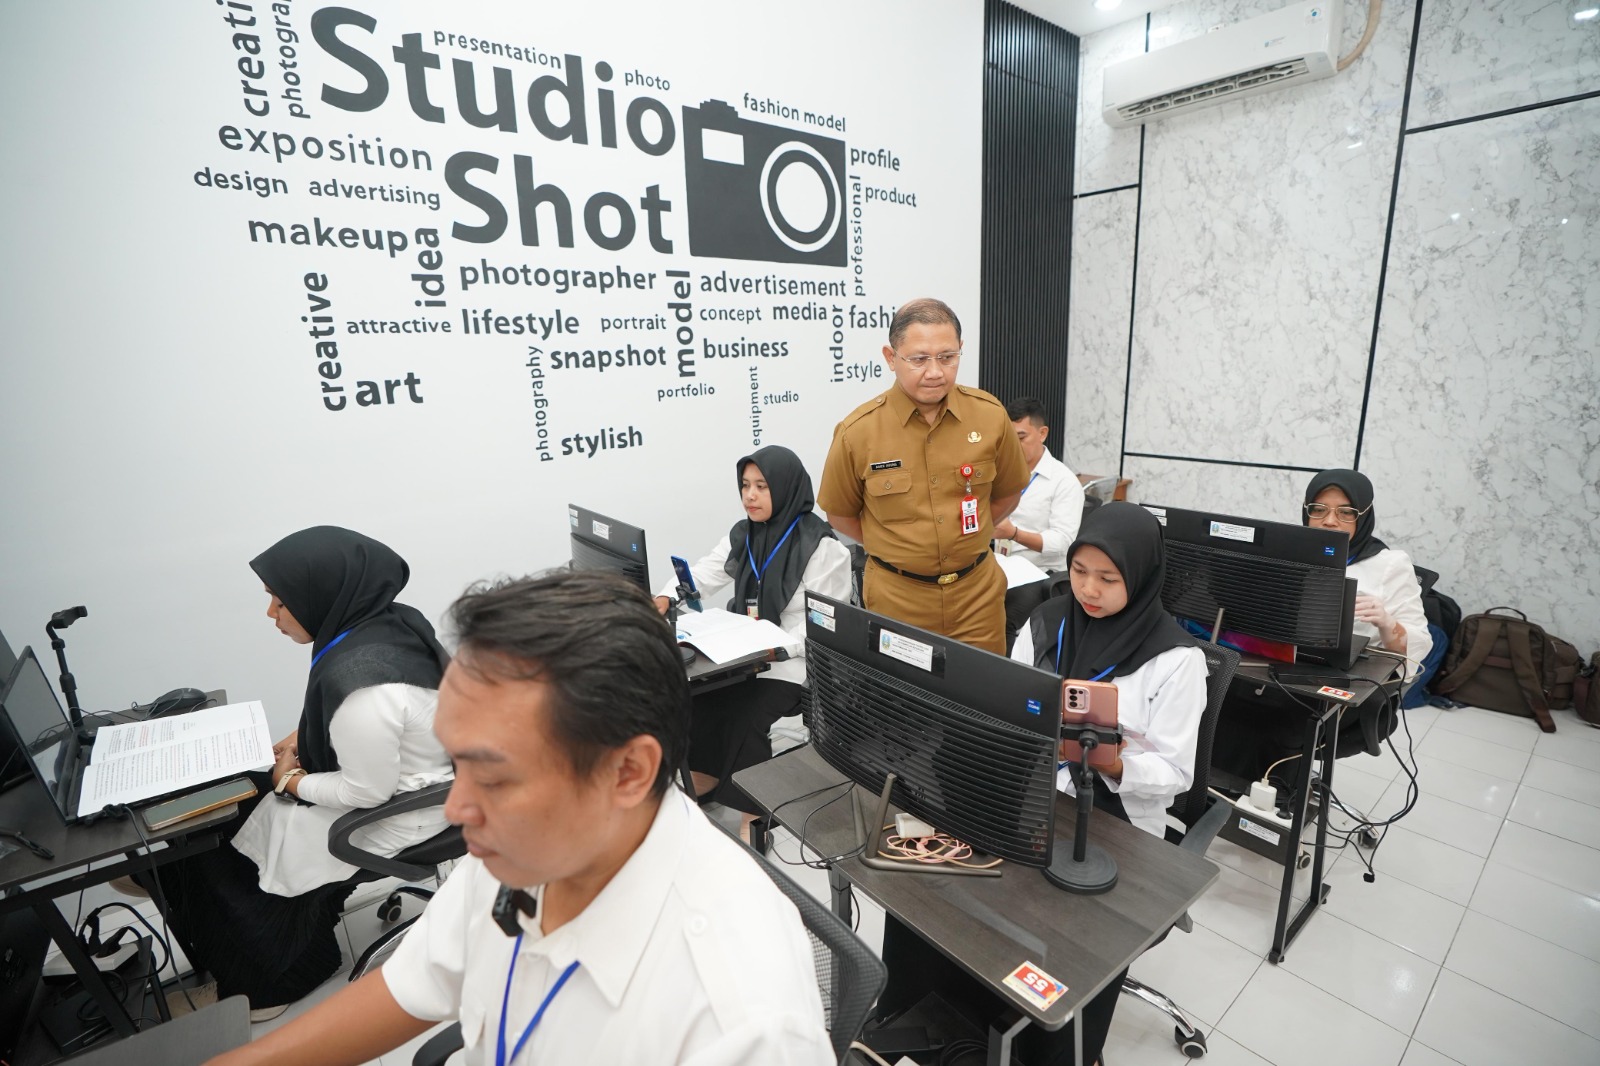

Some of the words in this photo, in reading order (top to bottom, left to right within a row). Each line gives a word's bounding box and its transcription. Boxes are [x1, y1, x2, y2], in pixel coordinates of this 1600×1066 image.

[272, 0, 311, 119] photogra
[434, 31, 561, 69] presentation
[309, 6, 676, 157] Studio
[625, 70, 670, 90] photo
[744, 93, 799, 120] fashion
[804, 112, 845, 132] model
[219, 125, 432, 171] exposition
[851, 148, 900, 171] profile
[194, 167, 288, 198] design
[309, 179, 440, 211] advertising
[866, 187, 916, 207] product
[444, 151, 673, 254] Shot
[248, 217, 408, 258] makeup
[849, 175, 866, 296] professional
[411, 228, 446, 307] idea
[460, 259, 656, 294] photographer
[701, 271, 846, 297] advertisement
[347, 317, 451, 334] attractive
[462, 309, 579, 341] lifestyle
[601, 314, 666, 333] portrait
[666, 270, 696, 377] model
[700, 307, 761, 324] concept
[773, 302, 827, 320] media
[301, 273, 346, 411] creative
[551, 344, 666, 372] snapshot
[703, 337, 788, 358] business
[829, 305, 843, 382] indoor
[847, 361, 881, 382] style
[356, 372, 423, 407] art
[526, 346, 553, 461] photography
[658, 383, 715, 402] portfolio
[764, 391, 799, 405] studio
[749, 366, 762, 446] equipment
[561, 426, 642, 458] stylish
[1023, 972, 1049, 992] 55
